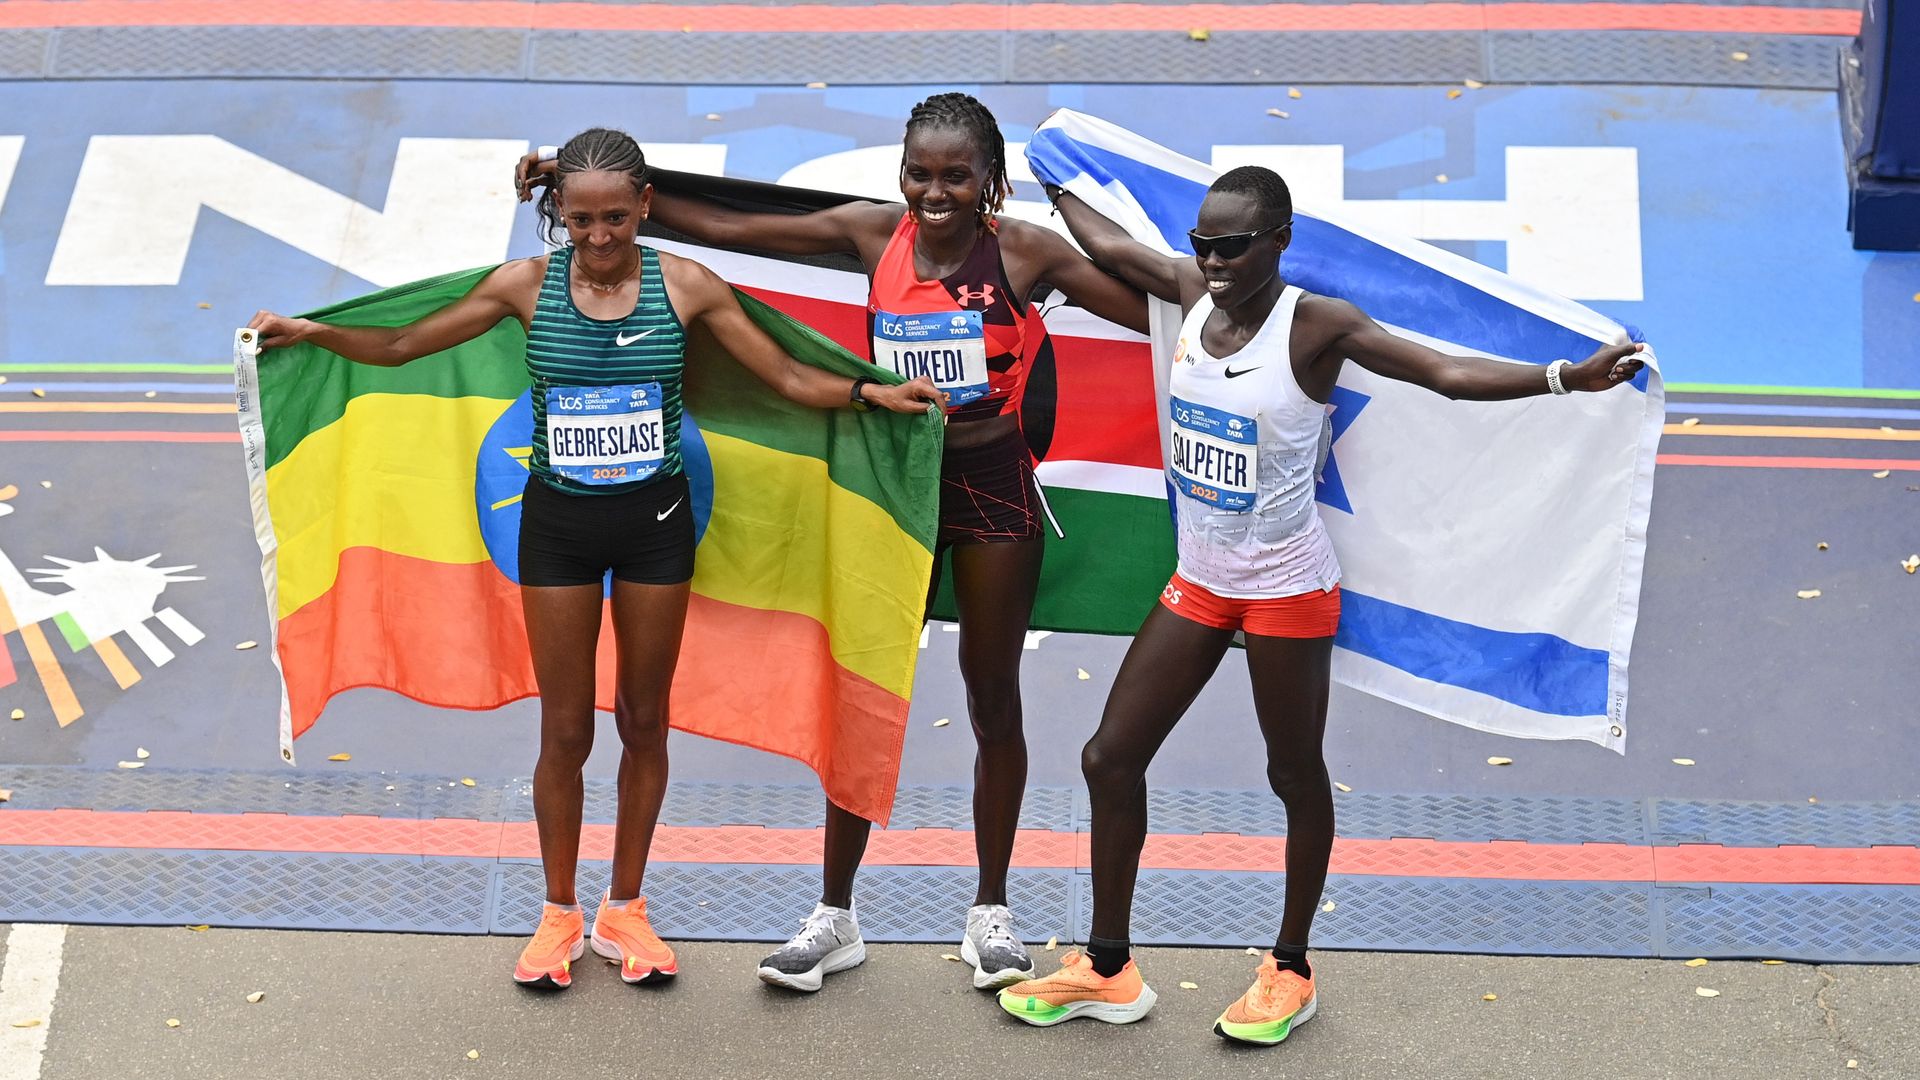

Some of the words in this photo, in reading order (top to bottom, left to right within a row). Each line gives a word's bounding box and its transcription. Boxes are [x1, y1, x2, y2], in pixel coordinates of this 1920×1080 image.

[882, 318, 903, 336] tcs
[558, 394, 582, 410] tcs
[629, 400, 648, 408] TATA
[1191, 408, 1205, 416] TATA
[553, 422, 660, 457] GEBRESLASE
[1226, 428, 1243, 439] TATA
[1173, 431, 1247, 488] SALPETER
[592, 467, 627, 479] 2022
[1190, 483, 1218, 502] 2022
